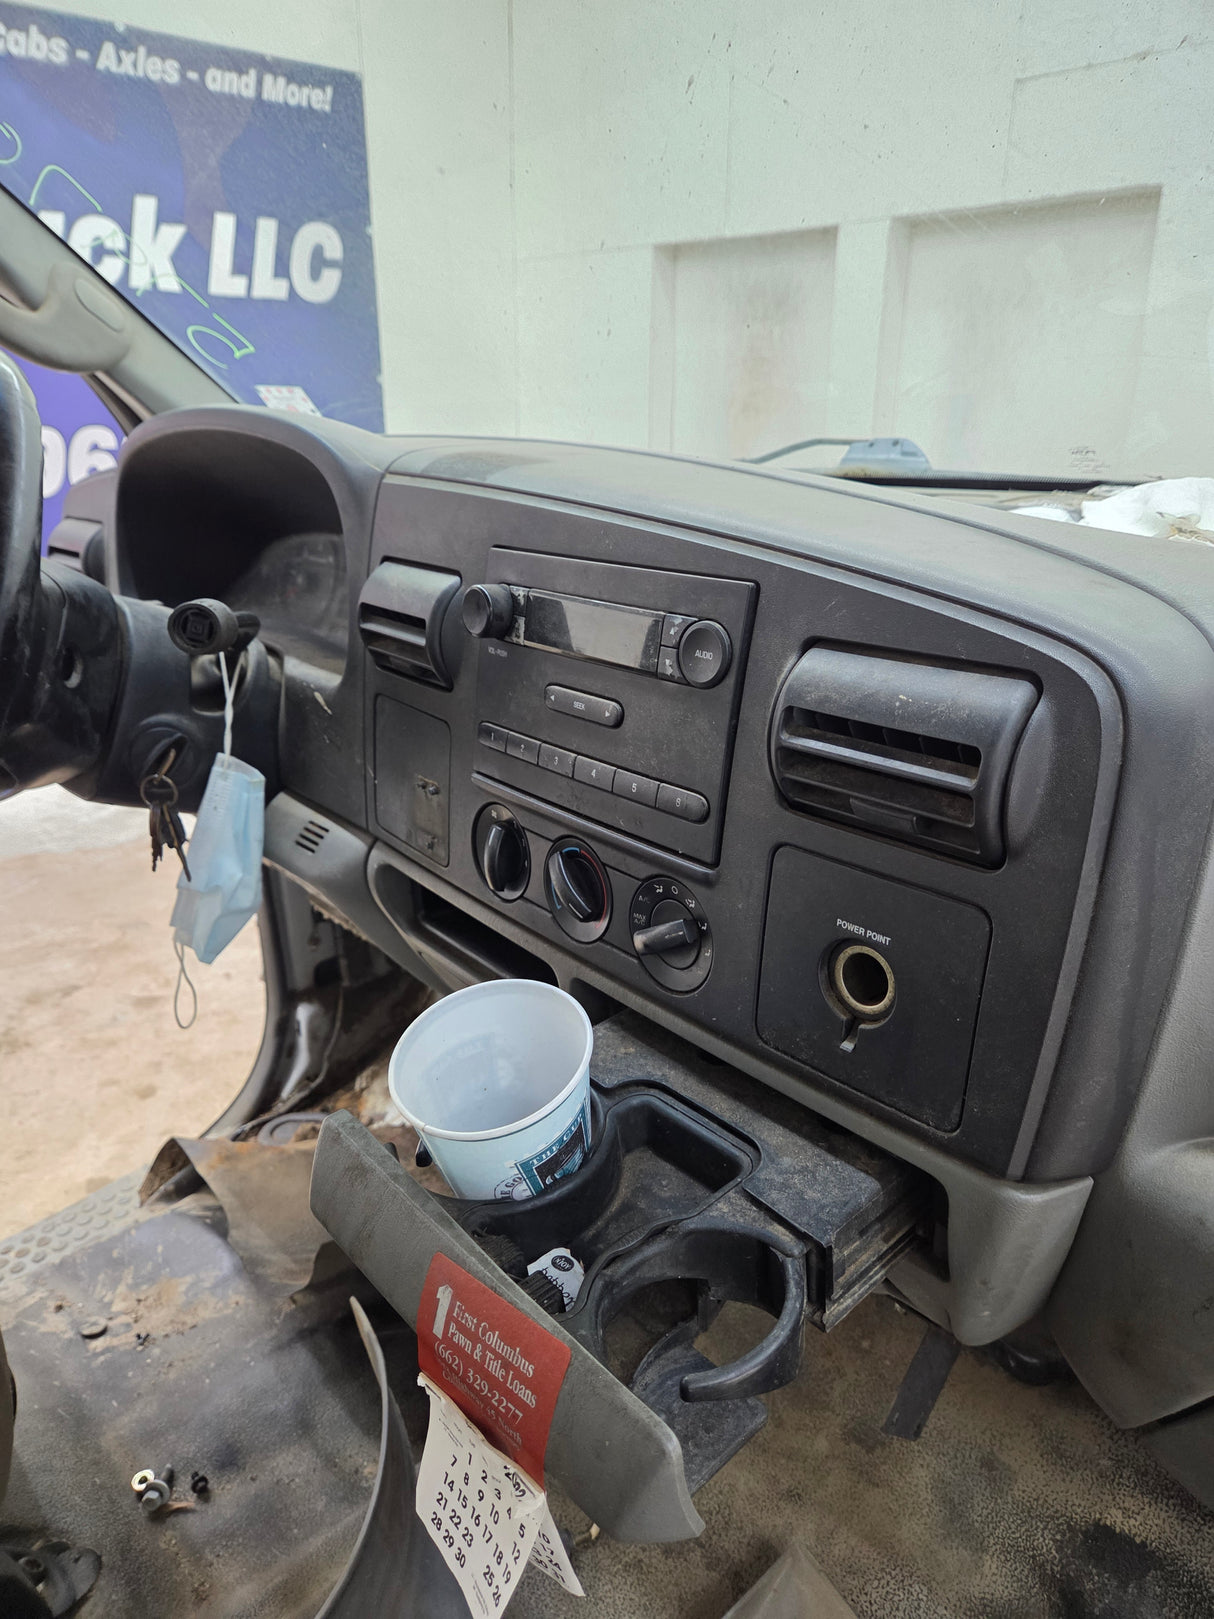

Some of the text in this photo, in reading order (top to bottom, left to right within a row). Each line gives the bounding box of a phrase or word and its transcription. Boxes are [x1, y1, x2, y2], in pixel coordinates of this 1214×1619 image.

[96, 40, 181, 84] Axles
[205, 67, 257, 99] and
[261, 73, 333, 113] More!
[208, 211, 344, 303] LLC
[695, 649, 714, 660] AUDIO
[573, 701, 585, 711] SEEK
[520, 744, 525, 754] 2
[553, 756, 558, 766] 3
[591, 768, 596, 778] 4
[631, 782, 637, 793] 5
[836, 919, 891, 946] POWER POINT
[530, 1143, 559, 1167] THE
[432, 1284, 453, 1340] 1
[452, 1301, 535, 1378] First Columbus
[434, 1340, 464, 1377] (662)
[466, 1368, 524, 1425] 329-2277
[447, 1321, 473, 1354] Pawn
[473, 1343, 483, 1363] &
[484, 1350, 506, 1381] Title
[506, 1370, 537, 1409] Loans
[443, 1471, 512, 1585] 14 15 16 17 18 19
[451, 1454, 521, 1565] 7 8 9 10 12
[467, 1452, 526, 1539] 1 2 3 4 5
[431, 1511, 466, 1569] 28 29 30
[436, 1491, 502, 1608] 21 22 23 25 26
